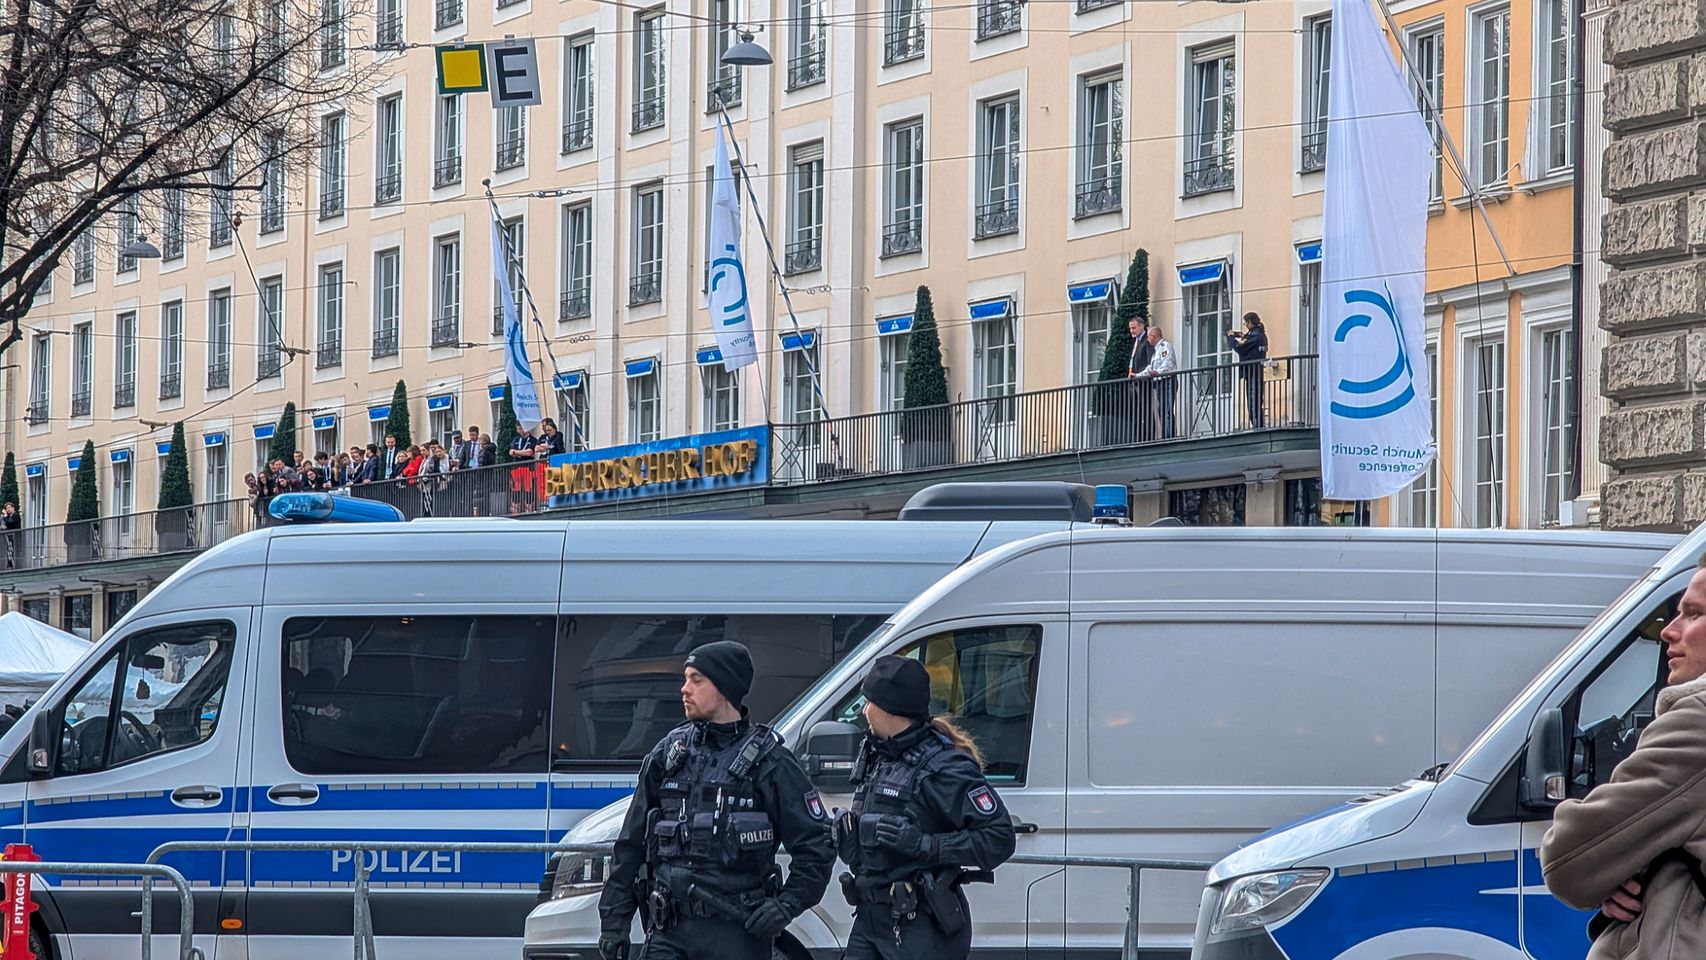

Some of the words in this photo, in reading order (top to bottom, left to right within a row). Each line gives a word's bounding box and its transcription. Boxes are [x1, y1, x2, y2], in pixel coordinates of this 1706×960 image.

[494, 46, 533, 101] E
[545, 447, 701, 497] BAYERISCHER
[701, 439, 758, 476] HOF
[332, 848, 461, 873] POLIZEI
[15, 872, 26, 925] PITAGON
